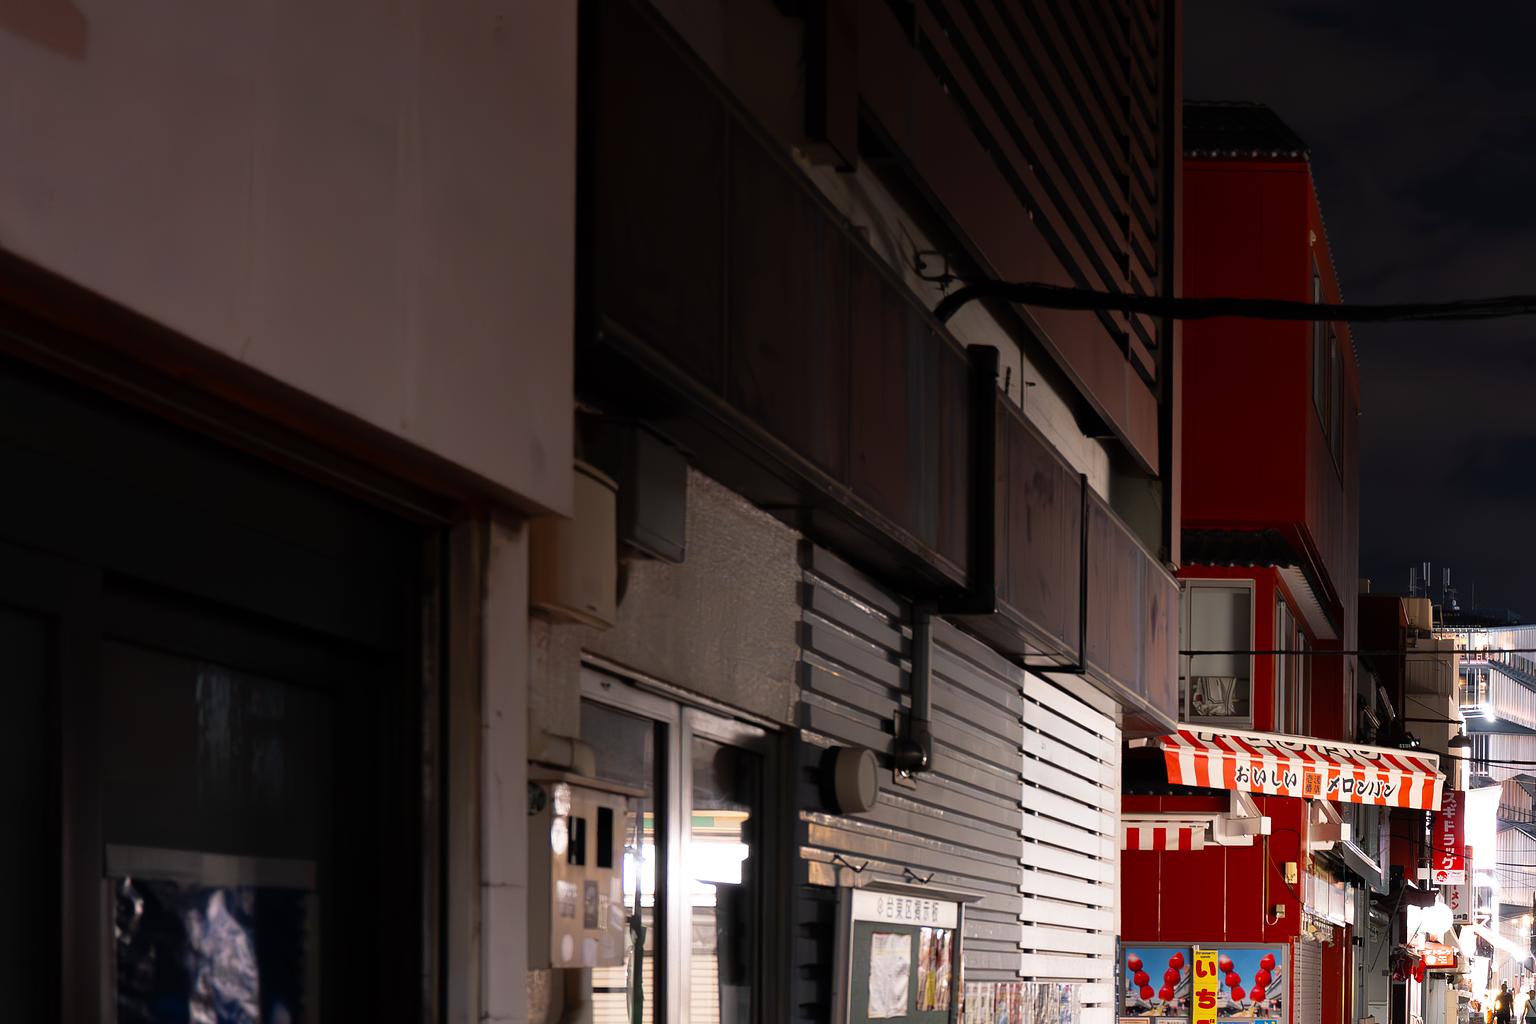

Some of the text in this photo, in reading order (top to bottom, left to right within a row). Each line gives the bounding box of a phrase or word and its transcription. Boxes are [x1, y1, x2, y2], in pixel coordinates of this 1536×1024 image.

[1236, 765, 1297, 788] おいしい
[1328, 777, 1396, 798] メロンパン
[1442, 792, 1457, 869] スギドラッグ
